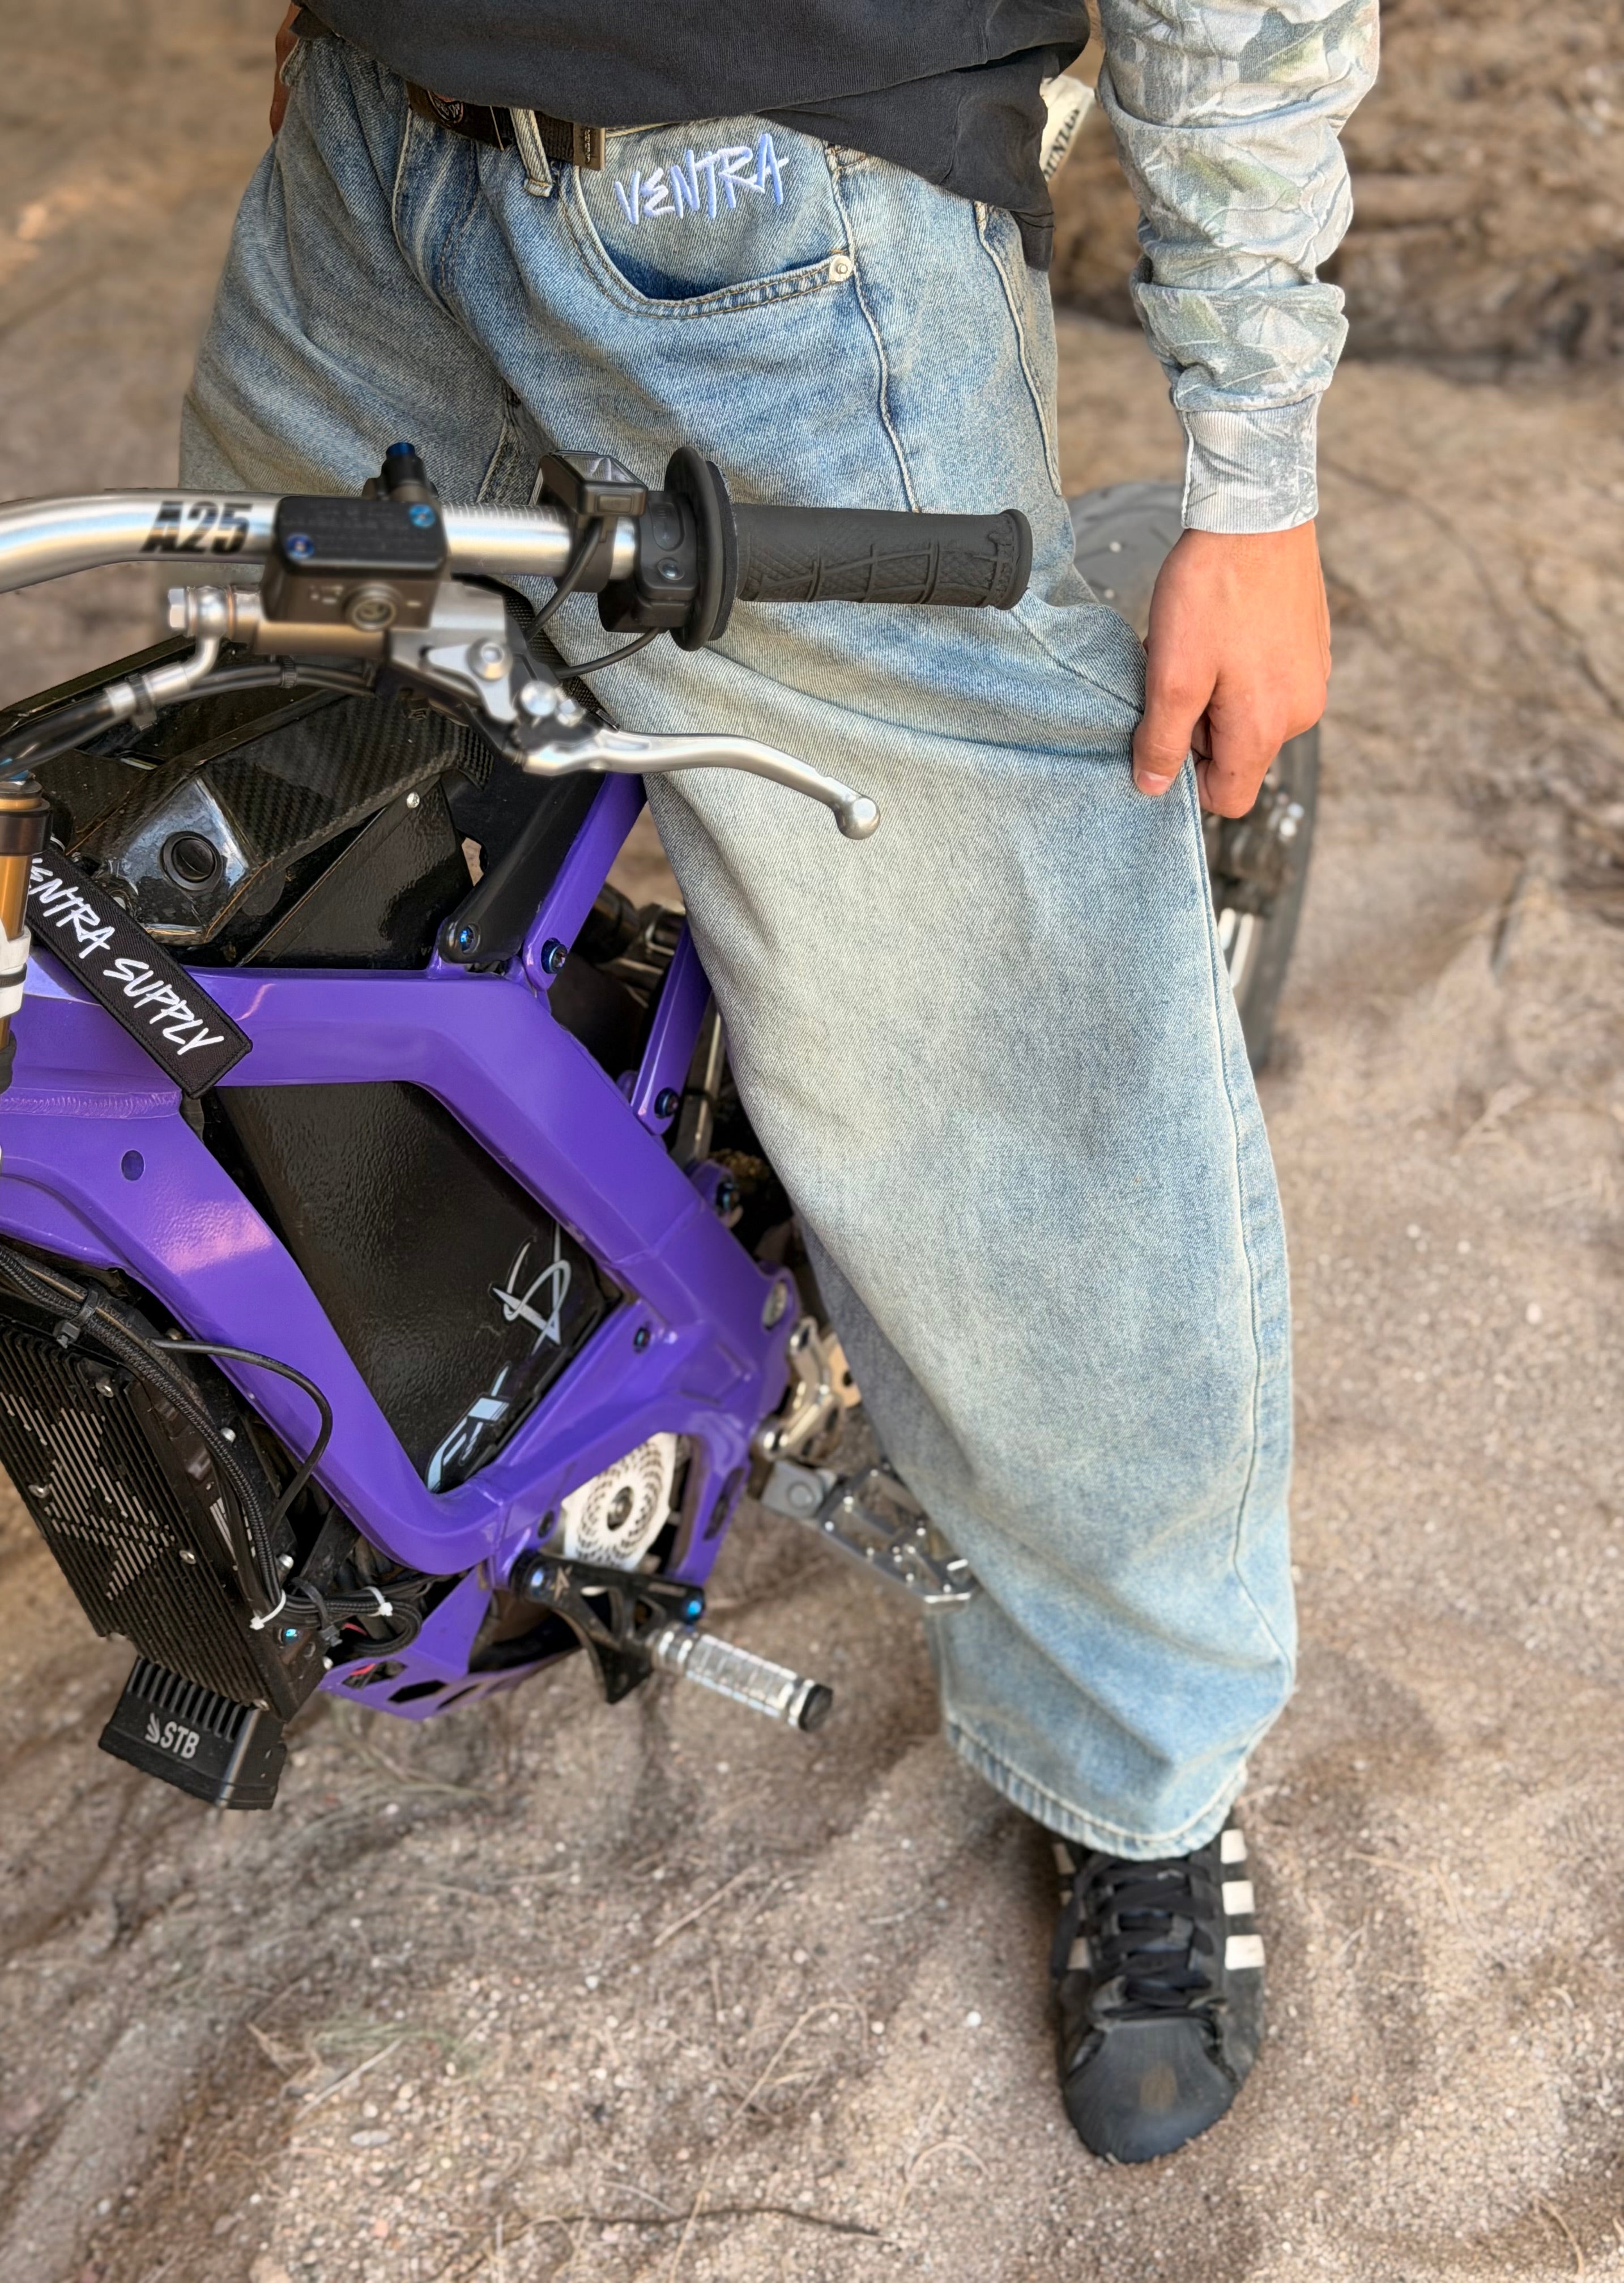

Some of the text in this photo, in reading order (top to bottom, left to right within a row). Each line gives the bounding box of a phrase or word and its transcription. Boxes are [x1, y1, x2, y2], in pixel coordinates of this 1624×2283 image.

[614, 133, 789, 224] VENTRA
[140, 501, 253, 555] A25
[28, 858, 224, 1055] ENTRA SUPPLY
[160, 1720, 200, 1759] STB
